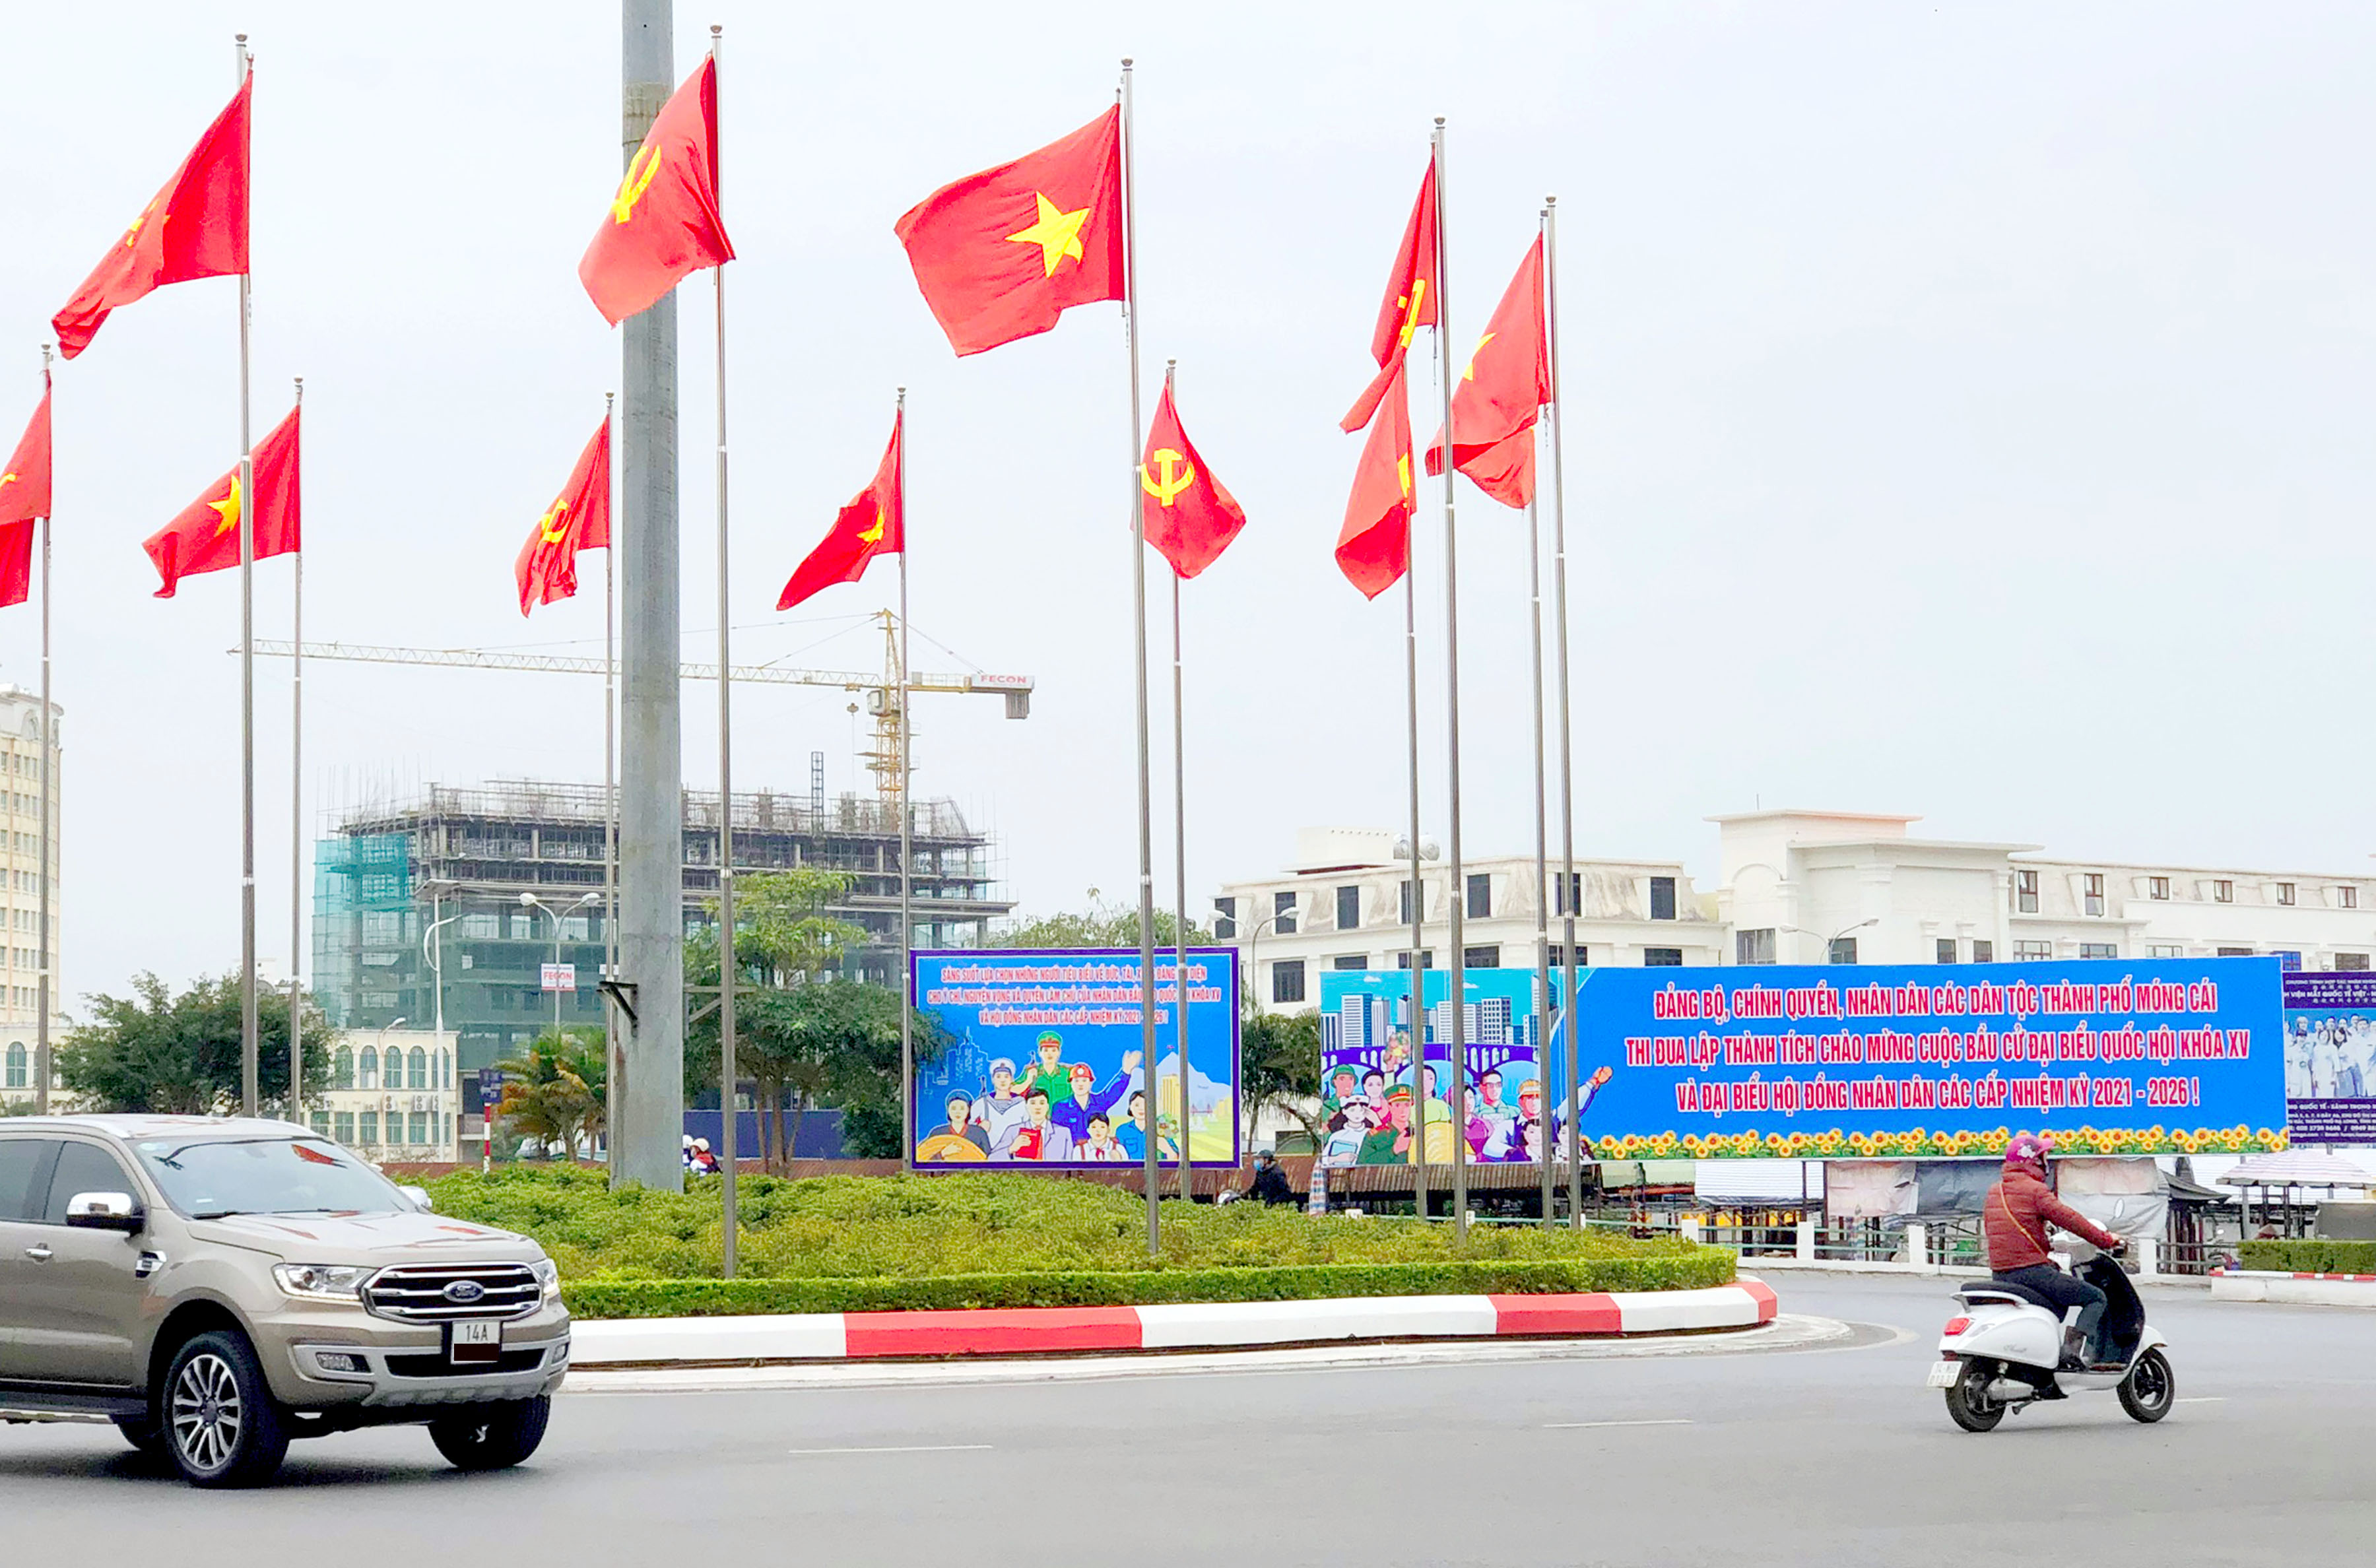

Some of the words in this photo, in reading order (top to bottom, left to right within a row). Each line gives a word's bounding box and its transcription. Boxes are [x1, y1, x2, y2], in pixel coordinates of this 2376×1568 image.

[981, 675, 1026, 684] FECON
[543, 971, 573, 981] FECON
[962, 964, 979, 981] SUỐT
[995, 967, 1014, 985] CHỌN
[1063, 964, 1076, 981] TIÊU
[1078, 962, 1094, 981] BIỂU
[928, 990, 942, 1003] CHO
[1012, 986, 1021, 1002] VÀ
[1046, 986, 1061, 1002] LÀM
[1092, 985, 1112, 1001] NHÂN
[1113, 985, 1128, 1001] DÂN
[1211, 988, 1221, 1000] XV
[1655, 983, 1698, 1018] ĐẢNG
[1703, 985, 1729, 1024] BỘ,
[1733, 983, 1781, 1017] CHÍNH
[1786, 980, 1843, 1020] QUYỀN,
[1847, 983, 1892, 1016] NHÂN
[1896, 982, 1929, 1015] DÂN
[1934, 981, 1965, 1014] CÁC
[1971, 981, 2003, 1014] DÂN
[2007, 980, 2037, 1019] TỘC
[2041, 979, 2094, 1012] THÀNH
[2099, 975, 2132, 1012] PHỐ
[2136, 978, 2184, 1012] MÓNG
[2189, 977, 2216, 1012] CÁI
[980, 1008, 989, 1024] VÀ
[990, 1008, 1003, 1028] HỘI
[1024, 1008, 1042, 1024] NHÂN
[1044, 1007, 1059, 1024] DÂN
[1059, 1007, 1072, 1024] CÁC
[1074, 1006, 1088, 1023] CẤP
[1090, 1007, 1113, 1028] NHIỆM
[1124, 1010, 1140, 1024] 2021
[1626, 1039, 1650, 1065] THI
[1655, 1038, 1686, 1064] ĐUA
[1690, 1031, 1719, 1070] LẬP
[1724, 1031, 1775, 1064] THÀNH
[1780, 1030, 1815, 1062] TÍCH
[1820, 1029, 1862, 1062] CHÀO
[1866, 1028, 1914, 1062] MỪNG
[1919, 1028, 1961, 1066] CUỘC
[1966, 1024, 1997, 1061] BẦU
[2002, 1024, 2025, 1059] CỬ
[2028, 1032, 2055, 1066] ĐẠI
[2060, 1021, 2096, 1059] BIỂU
[2101, 1021, 2143, 1062] QUỐC
[2149, 1025, 2175, 1064] HỘI
[2180, 1024, 2224, 1058] KHÓA
[2228, 1030, 2249, 1058] XV
[1677, 1078, 1698, 1111] VÀ
[1702, 1084, 1728, 1117] ĐẠI
[1732, 1072, 1768, 1110] BIỂU
[1773, 1077, 1800, 1115] HỘI
[1804, 1072, 1847, 1109] ĐỒNG
[1852, 1076, 1896, 1109] NHÂN
[1901, 1075, 1934, 1108] DÂN
[1939, 1074, 1971, 1107] CÁC
[1975, 1070, 2007, 1107] CẤP
[2012, 1073, 2064, 1112] NHIỆM
[2069, 1072, 2089, 1106] KỲ
[2094, 1078, 2130, 1105] 2021
[2148, 1078, 2188, 1105] 2026
[455, 1285, 477, 1297] Ford
[466, 1324, 488, 1342] 14A
